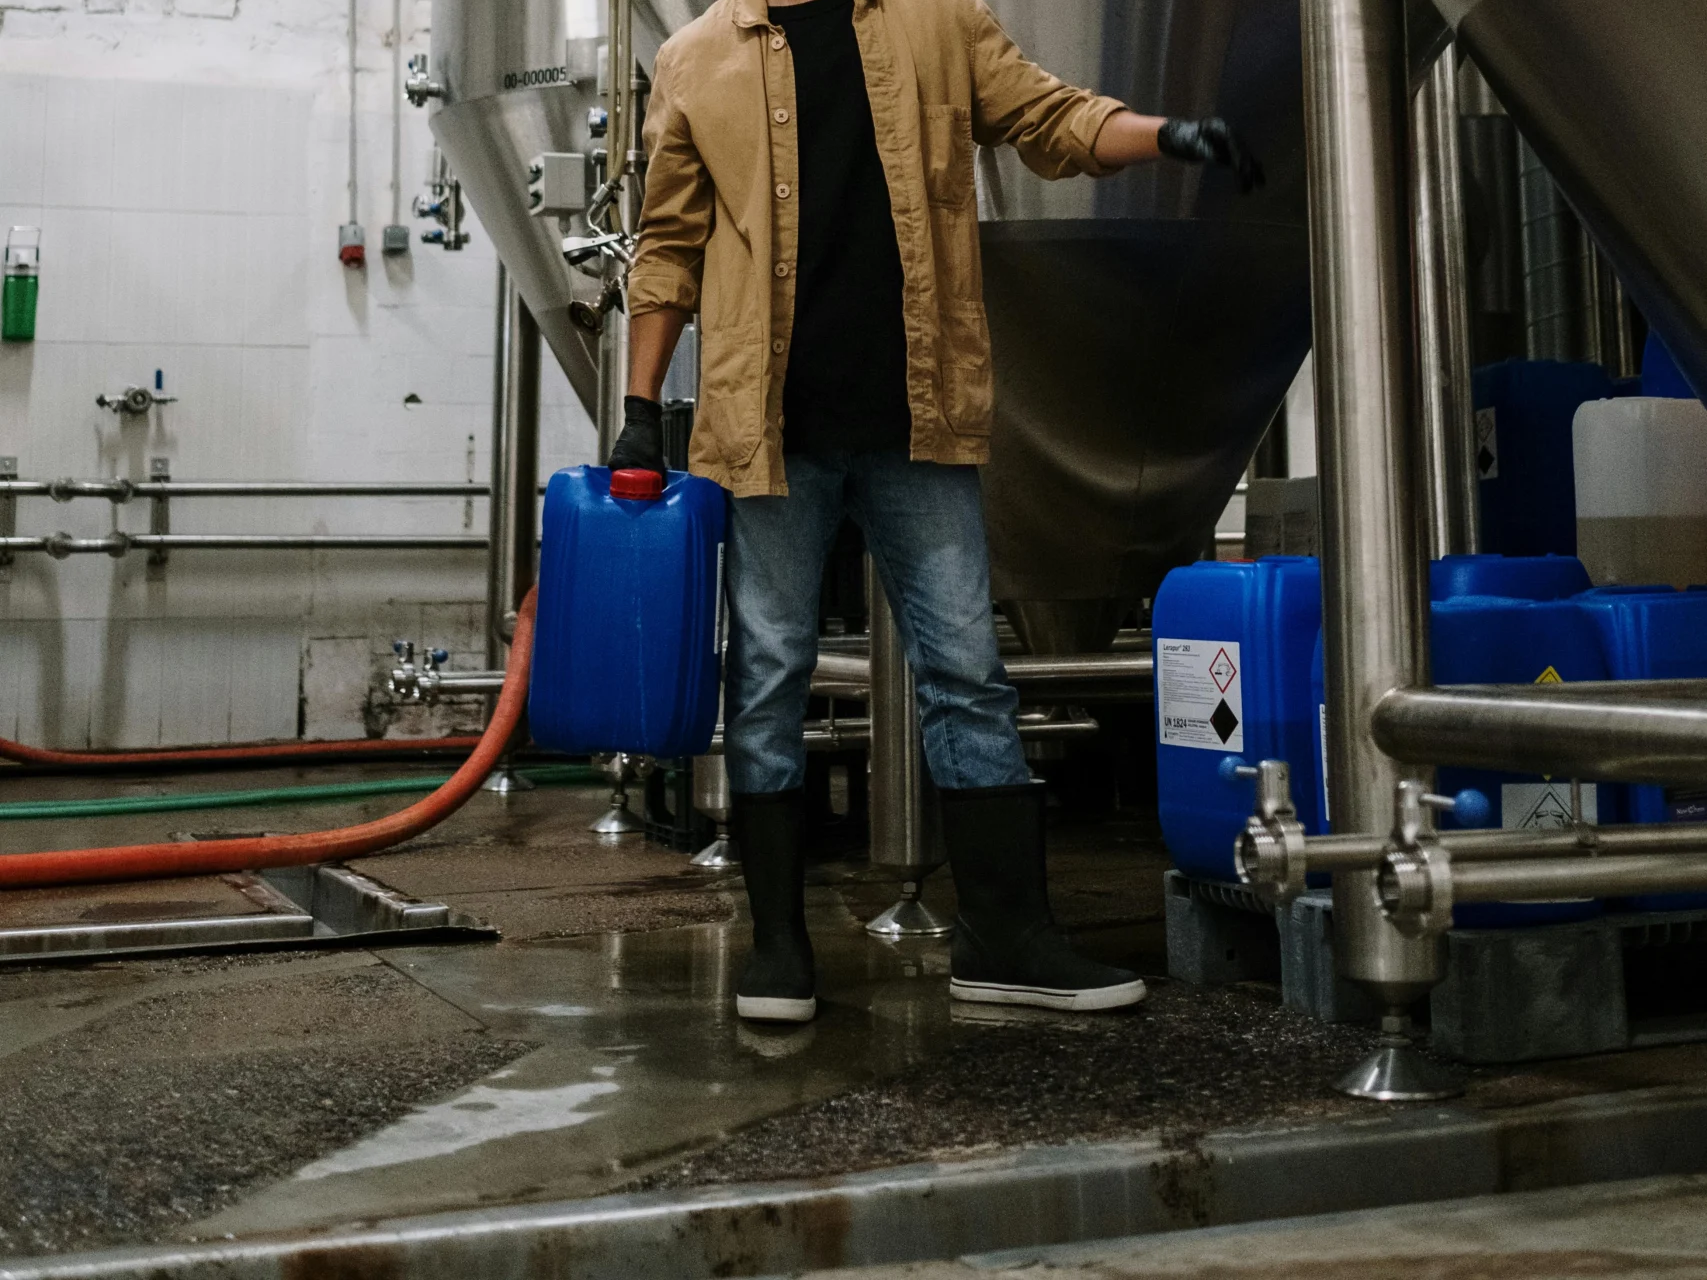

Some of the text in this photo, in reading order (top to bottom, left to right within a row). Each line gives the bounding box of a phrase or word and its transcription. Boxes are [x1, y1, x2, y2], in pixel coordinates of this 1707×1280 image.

[504, 67, 566, 89] 00-000005
[1164, 717, 1172, 727] UN
[1173, 718, 1187, 728] 1824
